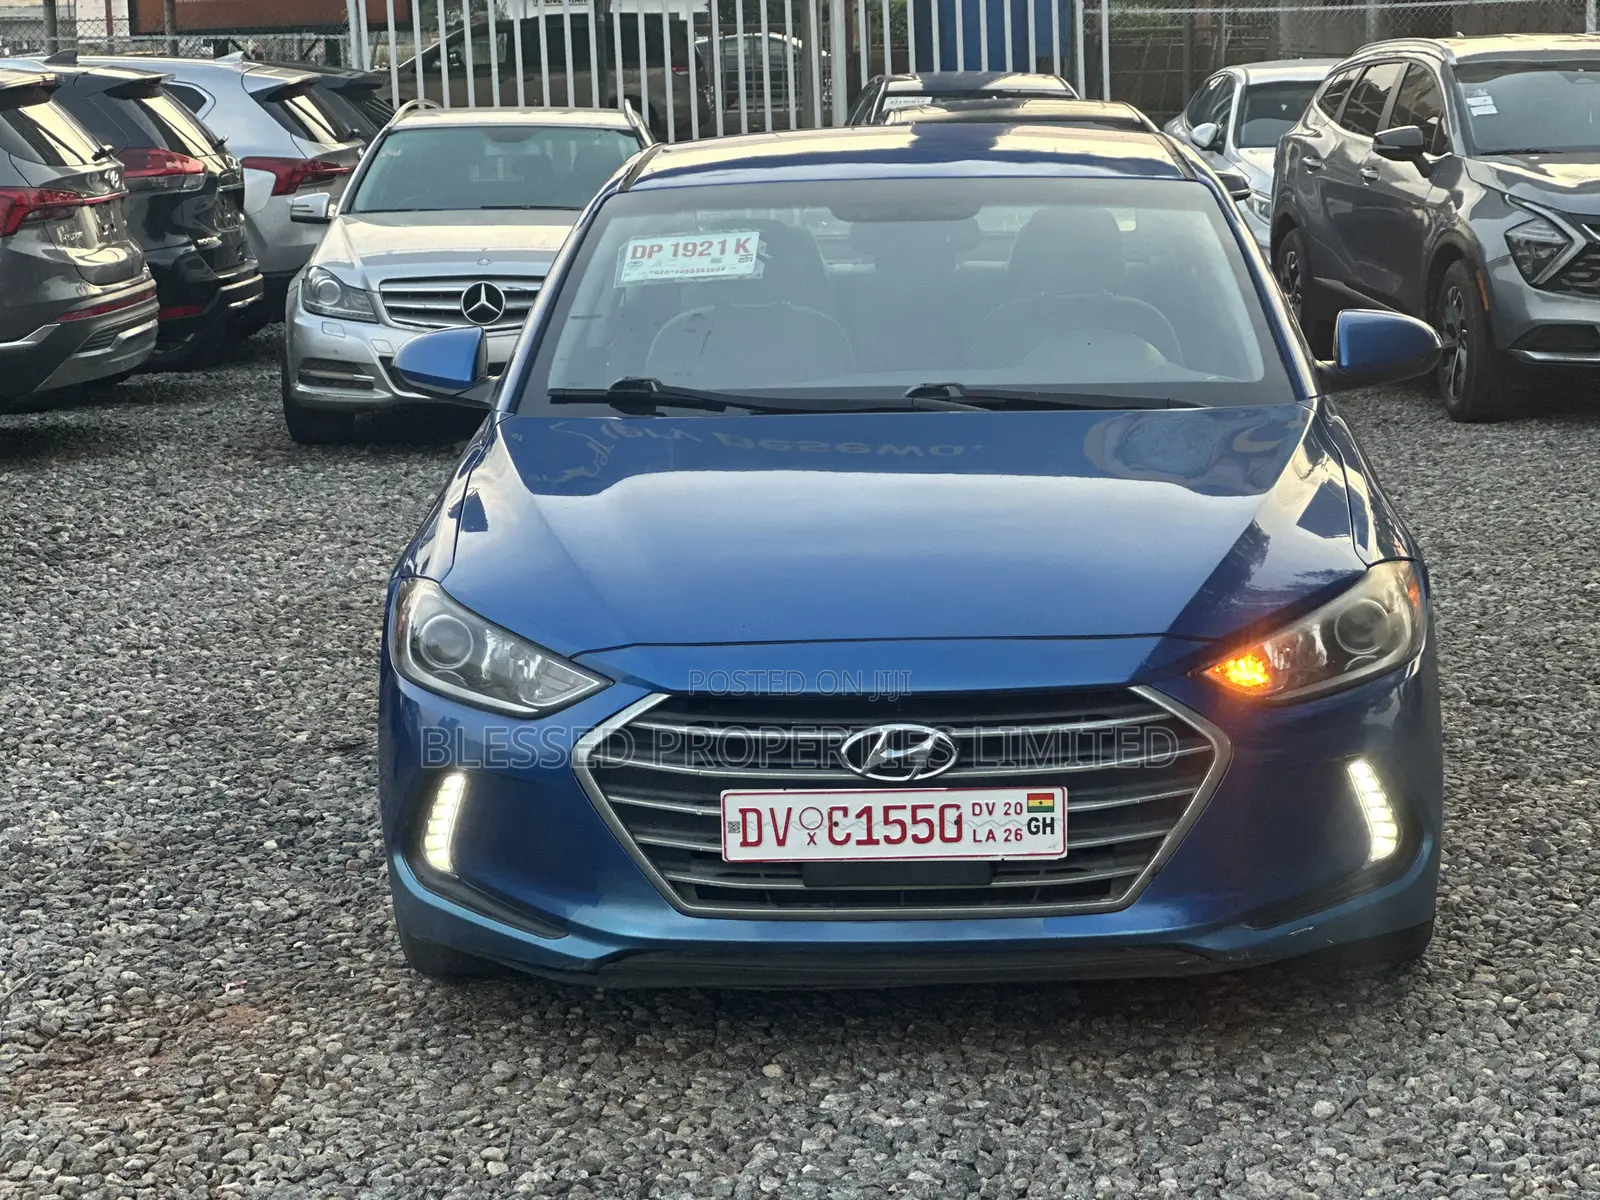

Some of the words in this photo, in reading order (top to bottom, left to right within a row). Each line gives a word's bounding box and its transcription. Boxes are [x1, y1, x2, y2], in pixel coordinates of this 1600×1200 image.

[630, 244, 664, 260] DP
[670, 239, 728, 258] 1921
[734, 237, 753, 255] K
[971, 802, 996, 817] DV
[1003, 801, 1023, 816] 20
[738, 807, 792, 847] DV
[827, 803, 963, 846] C1550
[1026, 816, 1055, 835] GH
[972, 828, 997, 843] LA
[1003, 827, 1023, 842] 26
